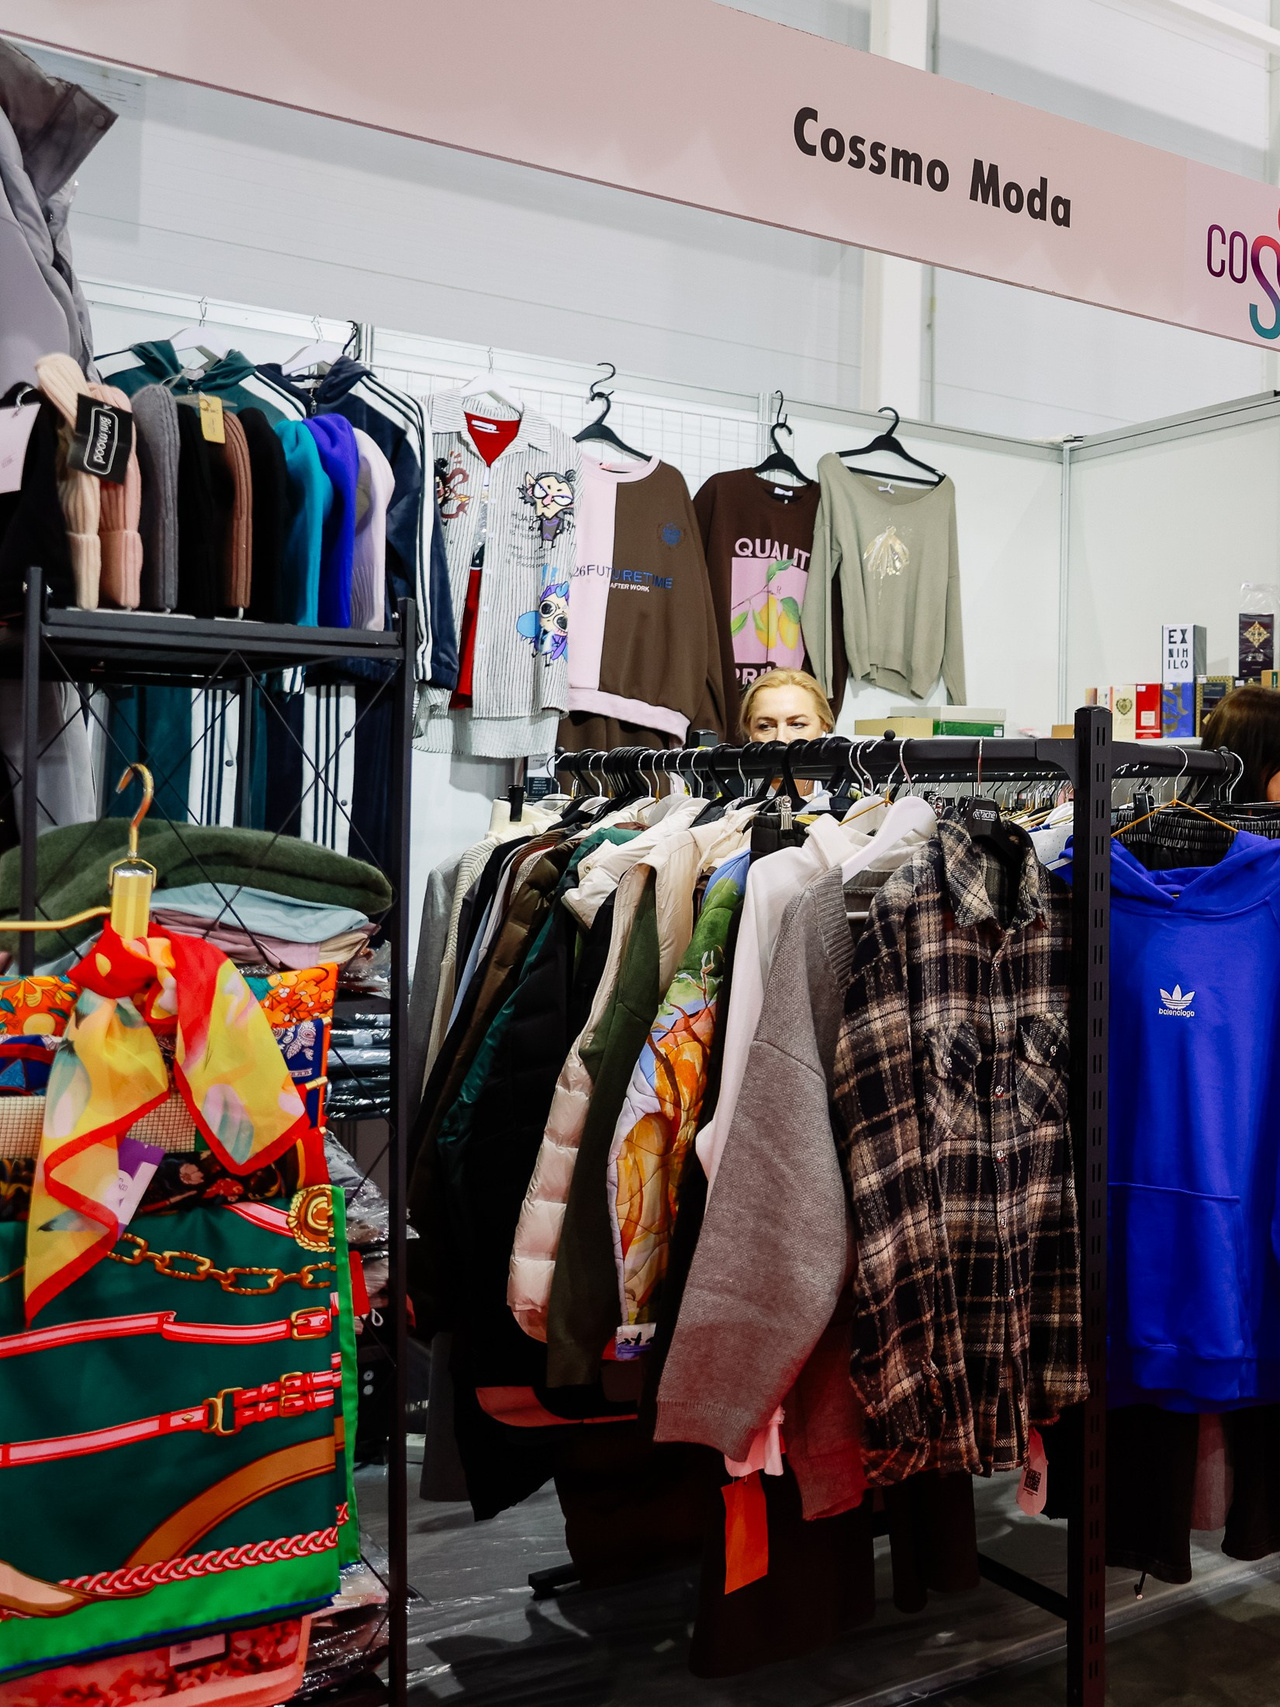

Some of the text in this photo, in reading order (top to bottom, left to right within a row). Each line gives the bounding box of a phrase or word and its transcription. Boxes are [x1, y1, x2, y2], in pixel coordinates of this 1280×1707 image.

[793, 107, 1072, 228] Cossmo Moda
[93, 432, 109, 465] mood
[734, 538, 811, 571] QUALIT
[610, 582, 650, 592] AFTER WORK
[1168, 629, 1188, 644] EX
